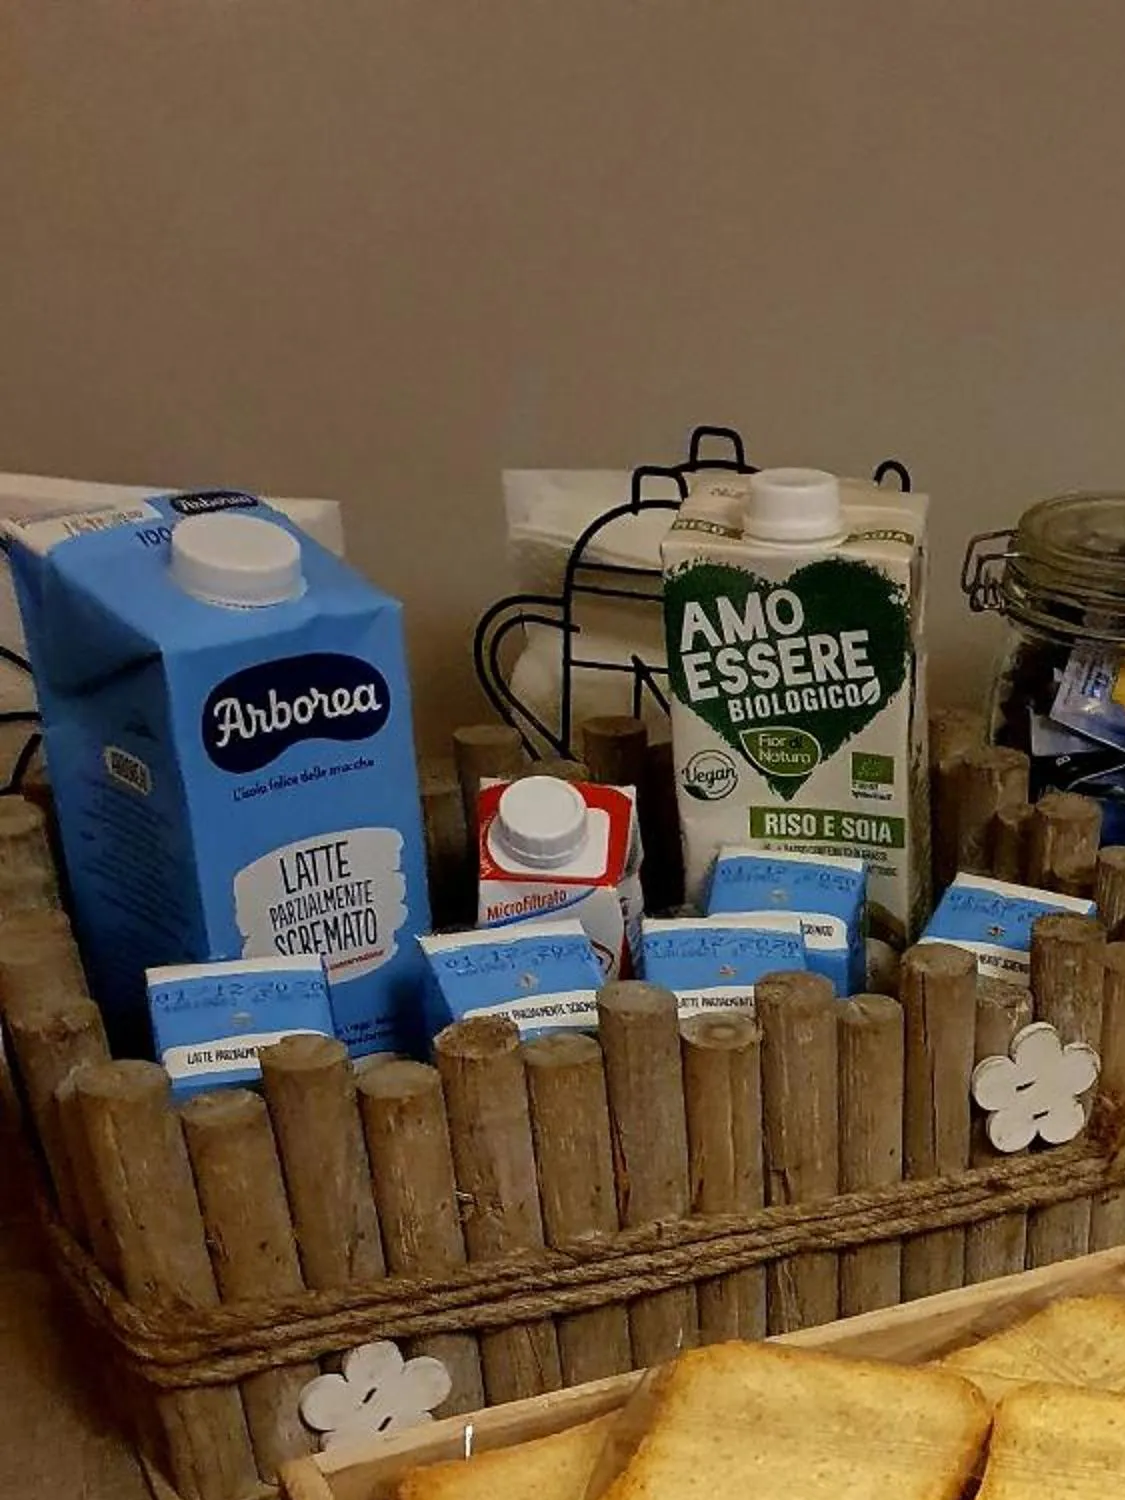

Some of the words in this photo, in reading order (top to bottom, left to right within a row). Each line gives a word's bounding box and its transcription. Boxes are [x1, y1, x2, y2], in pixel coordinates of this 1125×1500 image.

[680, 589, 804, 652] AMO
[681, 629, 875, 703] ESSERE
[213, 681, 382, 748] Arborea
[727, 682, 863, 724] BIOLOGICO
[758, 733, 787, 748] Fior
[758, 749, 811, 764] Natura
[682, 765, 737, 789] Vegan
[764, 813, 817, 836] RISO
[824, 815, 835, 837] E
[841, 817, 893, 844] SOIA
[279, 841, 351, 894] LATTE
[269, 879, 375, 932] PARZIALMENTE
[273, 907, 377, 955] SCREMATO
